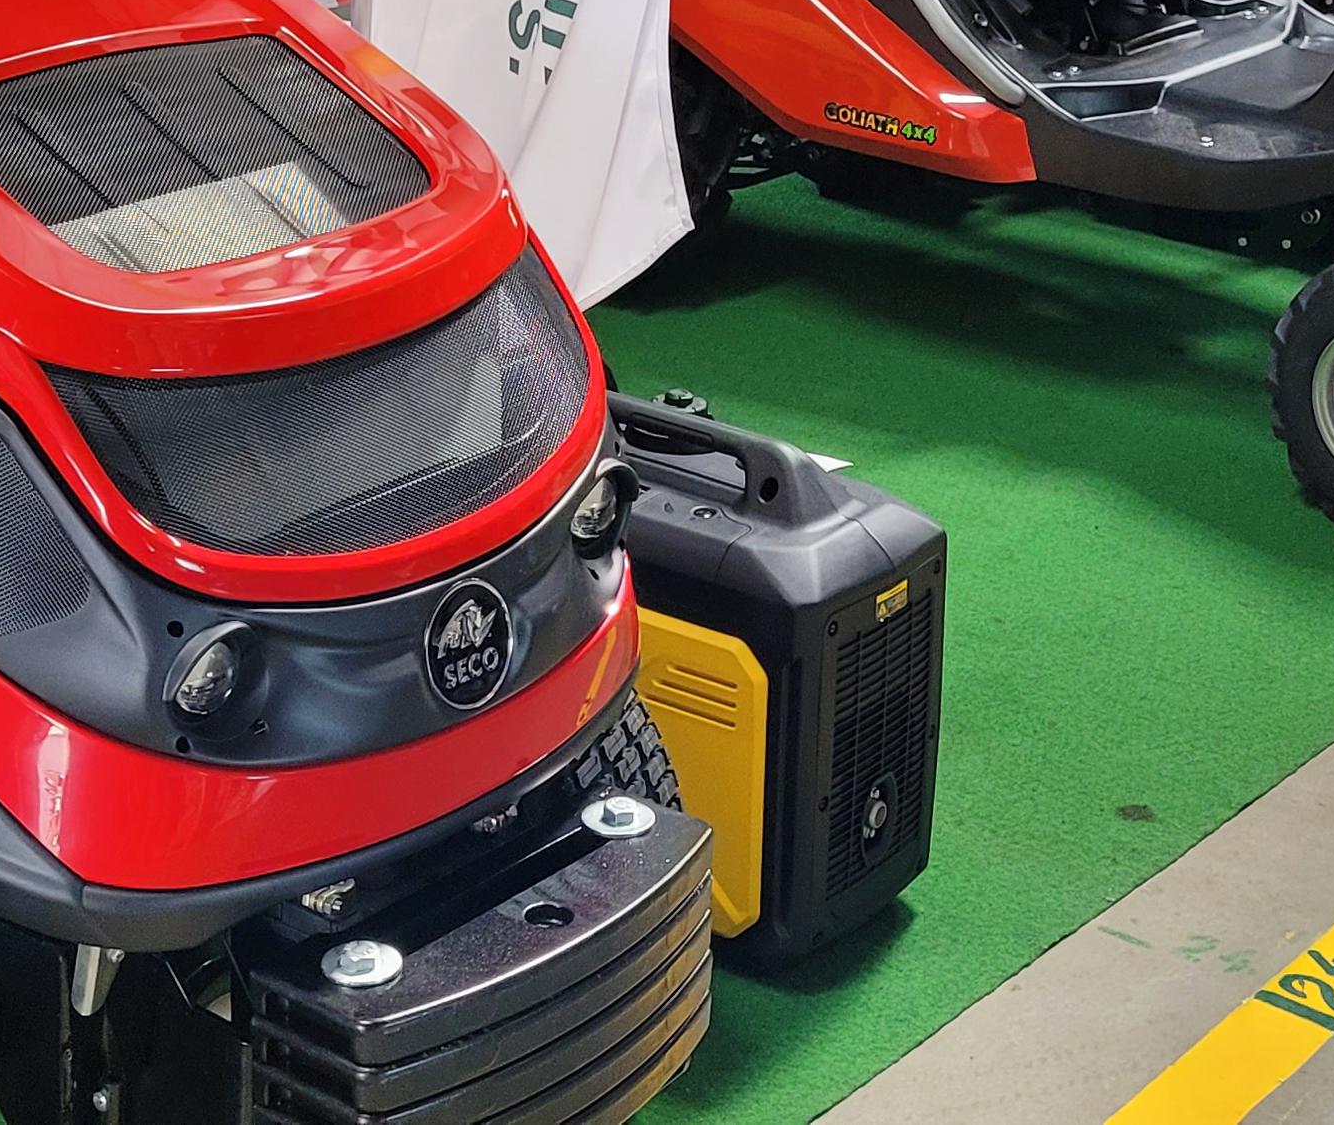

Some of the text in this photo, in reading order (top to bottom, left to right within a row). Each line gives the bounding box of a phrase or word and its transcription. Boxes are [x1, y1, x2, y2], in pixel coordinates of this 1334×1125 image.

[825, 102, 937, 145] GOLIATH 4x4
[443, 645, 500, 691] SECO
